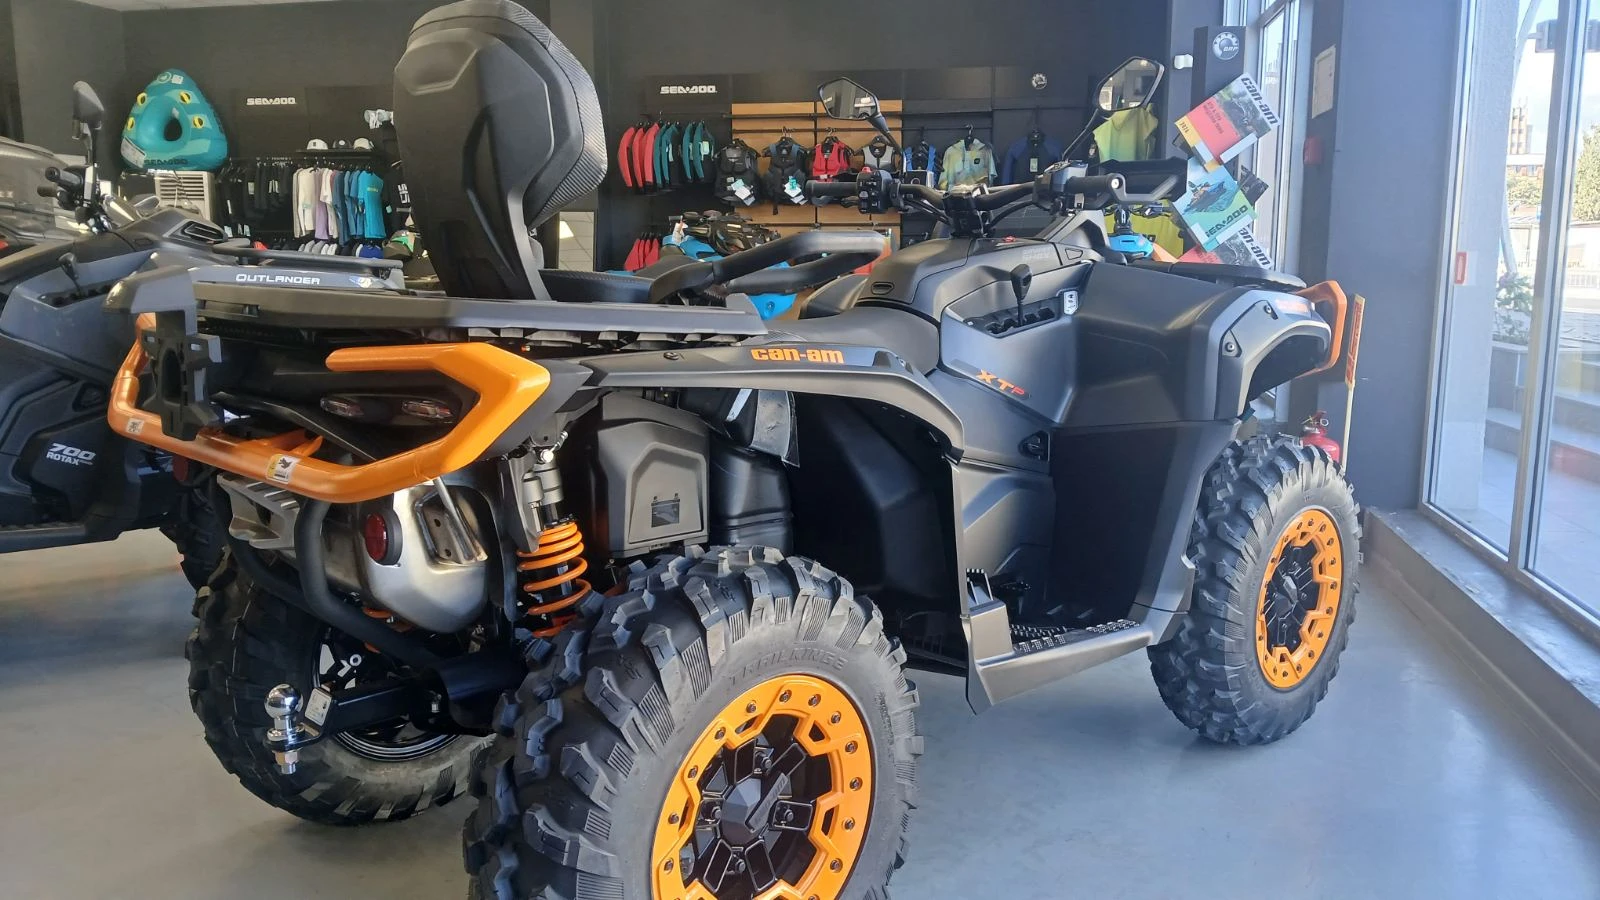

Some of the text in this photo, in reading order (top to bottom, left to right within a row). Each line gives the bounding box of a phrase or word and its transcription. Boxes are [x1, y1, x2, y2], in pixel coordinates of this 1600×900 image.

[1241, 77, 1279, 125] can-am
[1238, 225, 1271, 266] an-am
[235, 273, 321, 285] OUTLANDER
[750, 348, 844, 364] can-am
[46, 451, 80, 466] ROTAX
[49, 442, 97, 461] 700
